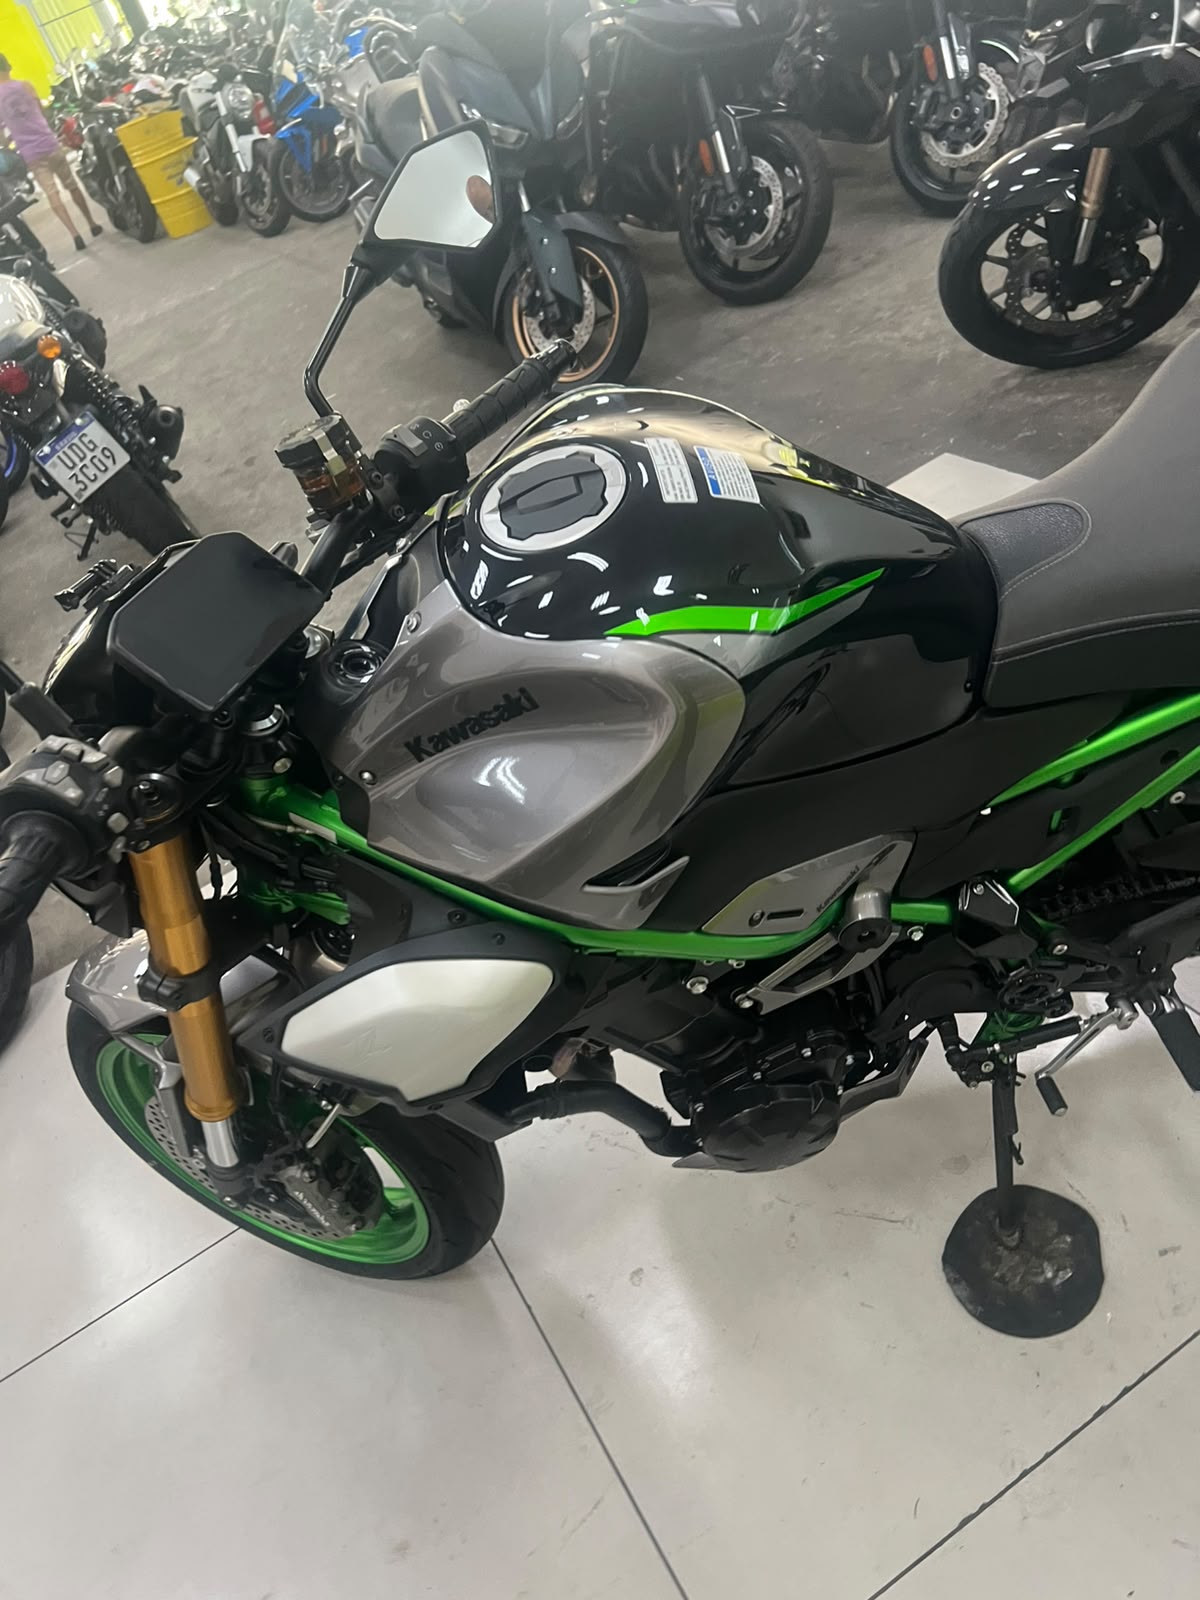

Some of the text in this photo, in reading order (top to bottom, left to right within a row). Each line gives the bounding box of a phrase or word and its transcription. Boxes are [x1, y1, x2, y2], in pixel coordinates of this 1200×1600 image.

[57, 432, 99, 470] UDG
[68, 446, 117, 492] 3C09
[403, 687, 541, 763] Kawasaki
[816, 864, 860, 913] Kawasaki
